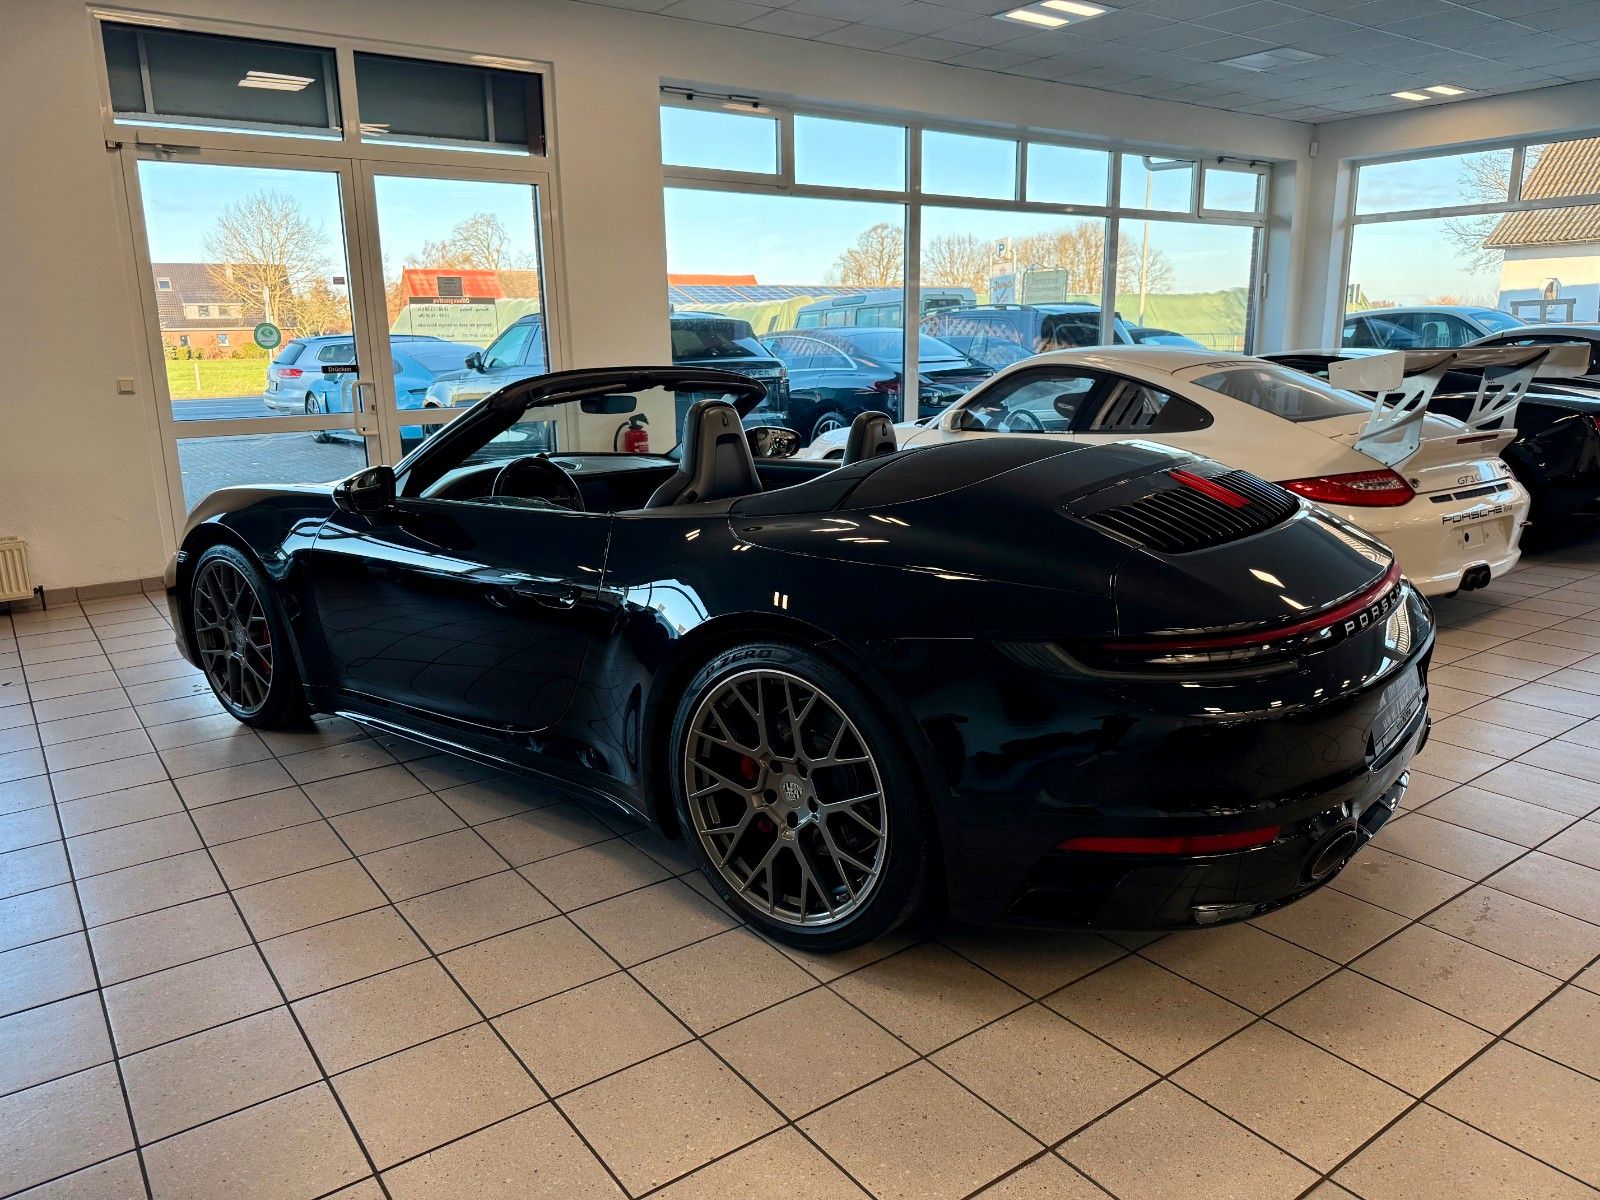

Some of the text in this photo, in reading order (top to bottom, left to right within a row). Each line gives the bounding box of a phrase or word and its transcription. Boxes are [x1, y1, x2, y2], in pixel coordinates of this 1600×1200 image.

[1442, 505, 1502, 525] PORSCHE
[1344, 584, 1401, 636] PORSCH
[719, 649, 774, 668] ZERO
